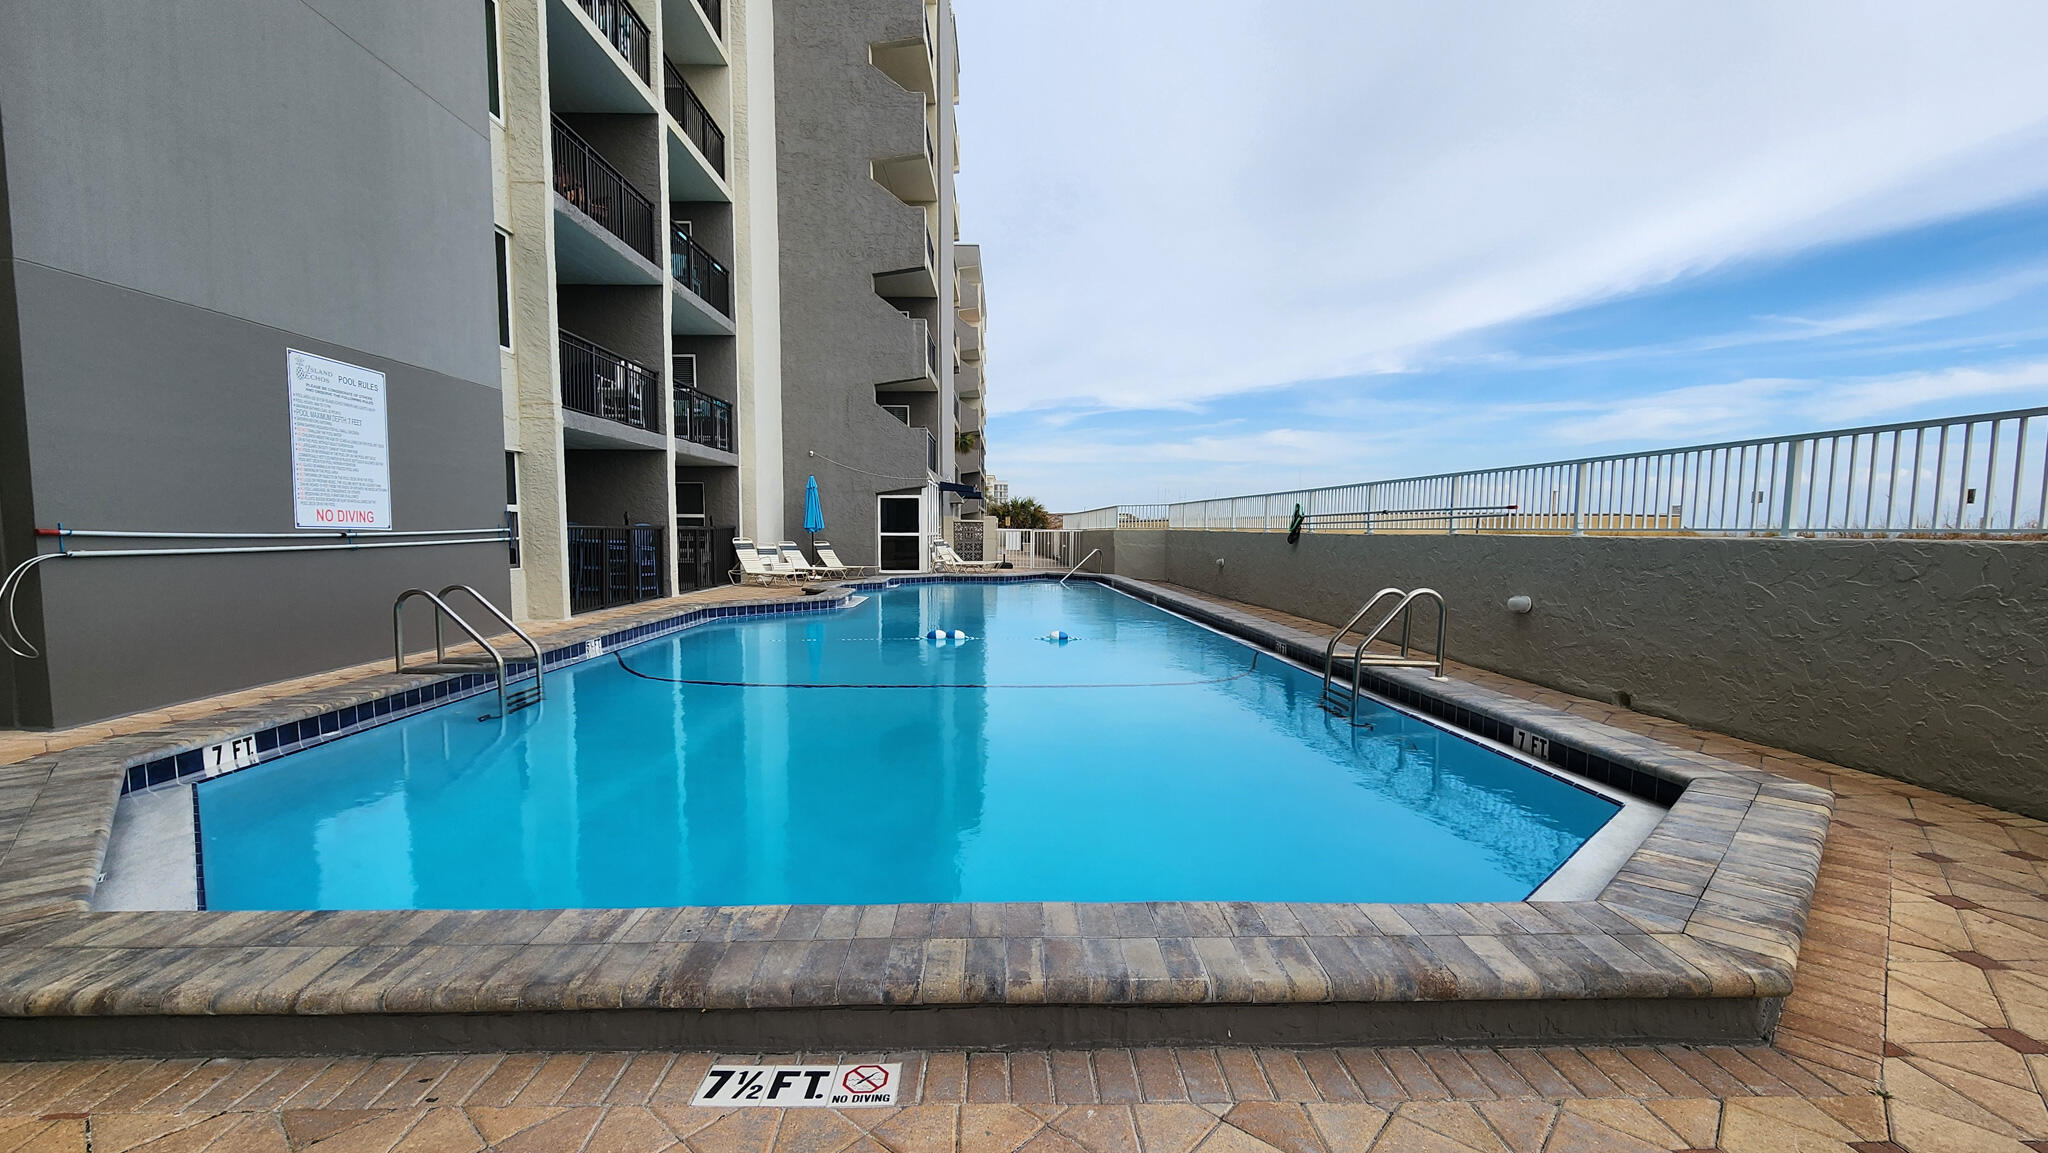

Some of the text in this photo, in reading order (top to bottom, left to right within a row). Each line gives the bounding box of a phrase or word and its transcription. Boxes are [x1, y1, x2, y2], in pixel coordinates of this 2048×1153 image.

[338, 375, 379, 392] POOL RULES
[316, 509, 374, 523] NO DIVING
[212, 736, 254, 765] 7 FT.
[1519, 731, 1548, 759] 7 FT.
[832, 1094, 891, 1103] NO DIVING
